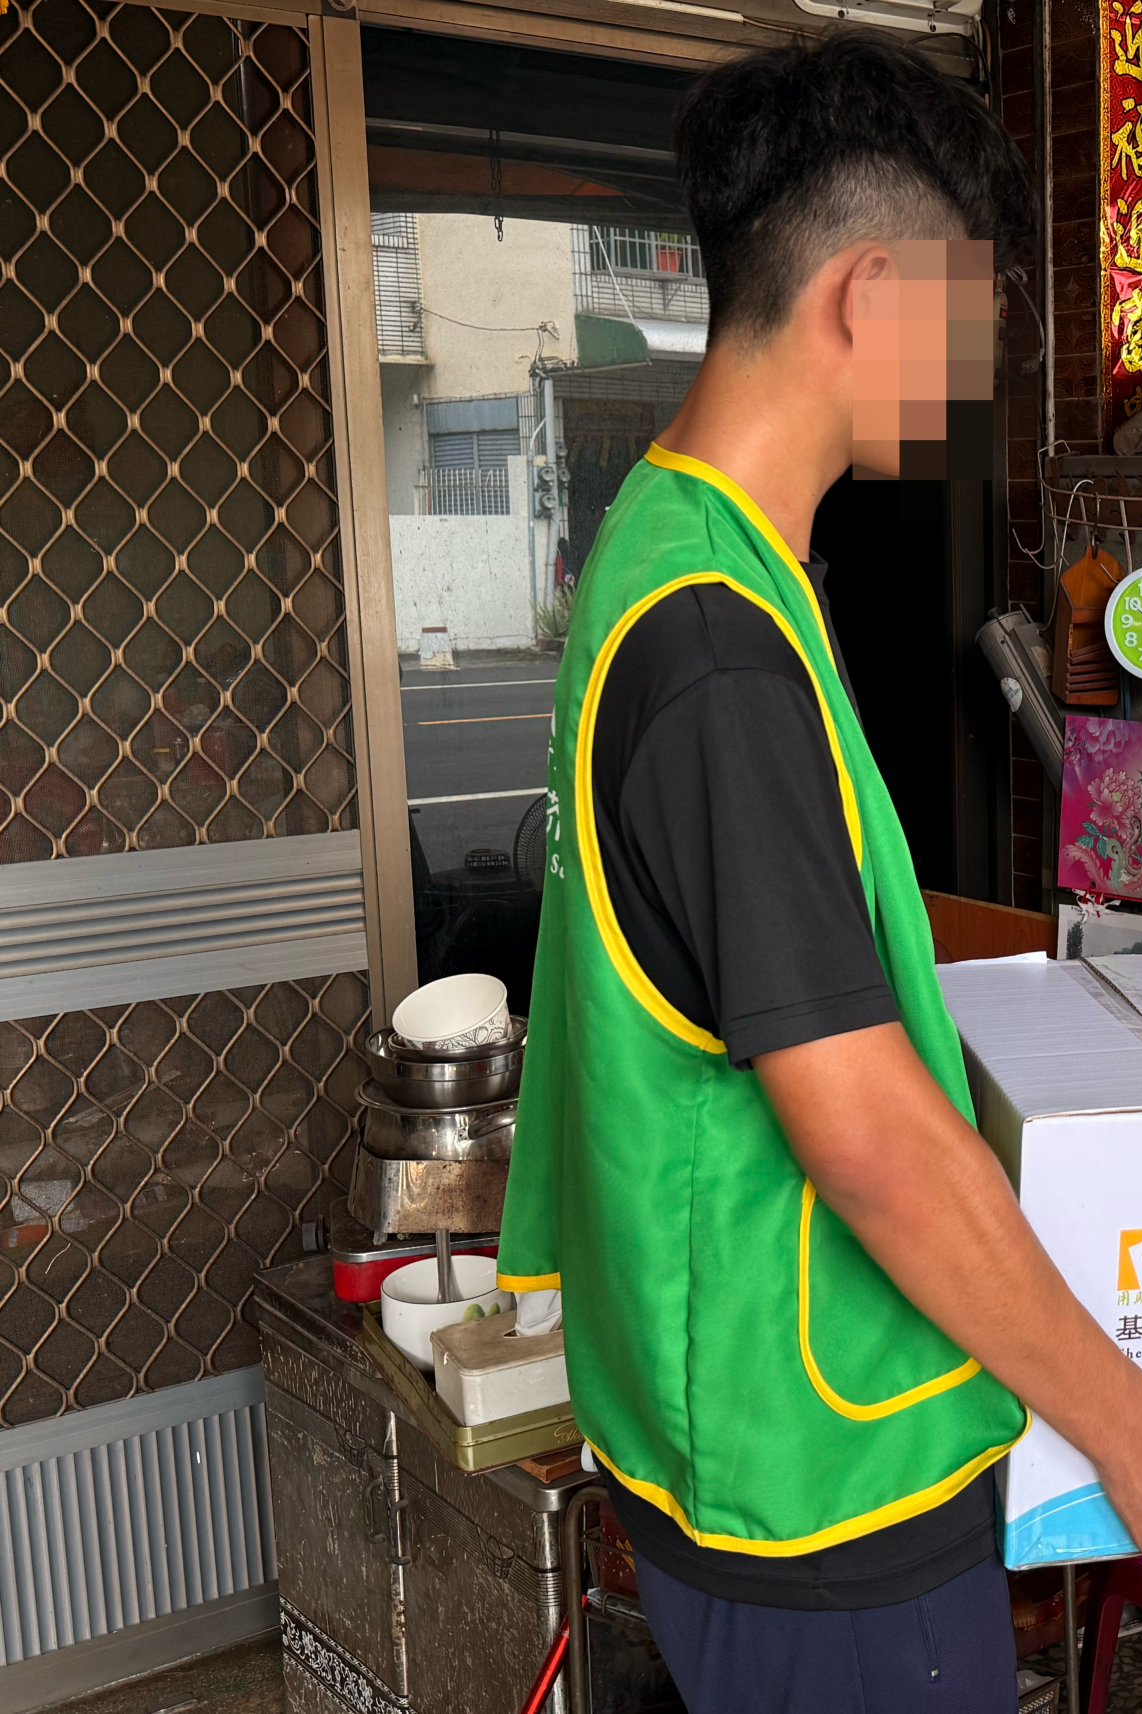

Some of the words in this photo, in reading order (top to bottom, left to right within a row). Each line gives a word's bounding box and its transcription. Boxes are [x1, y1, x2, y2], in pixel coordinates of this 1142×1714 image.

[1125, 597, 1141, 611] 10
[1121, 614, 1134, 628] 9
[1124, 632, 1137, 647] 8
